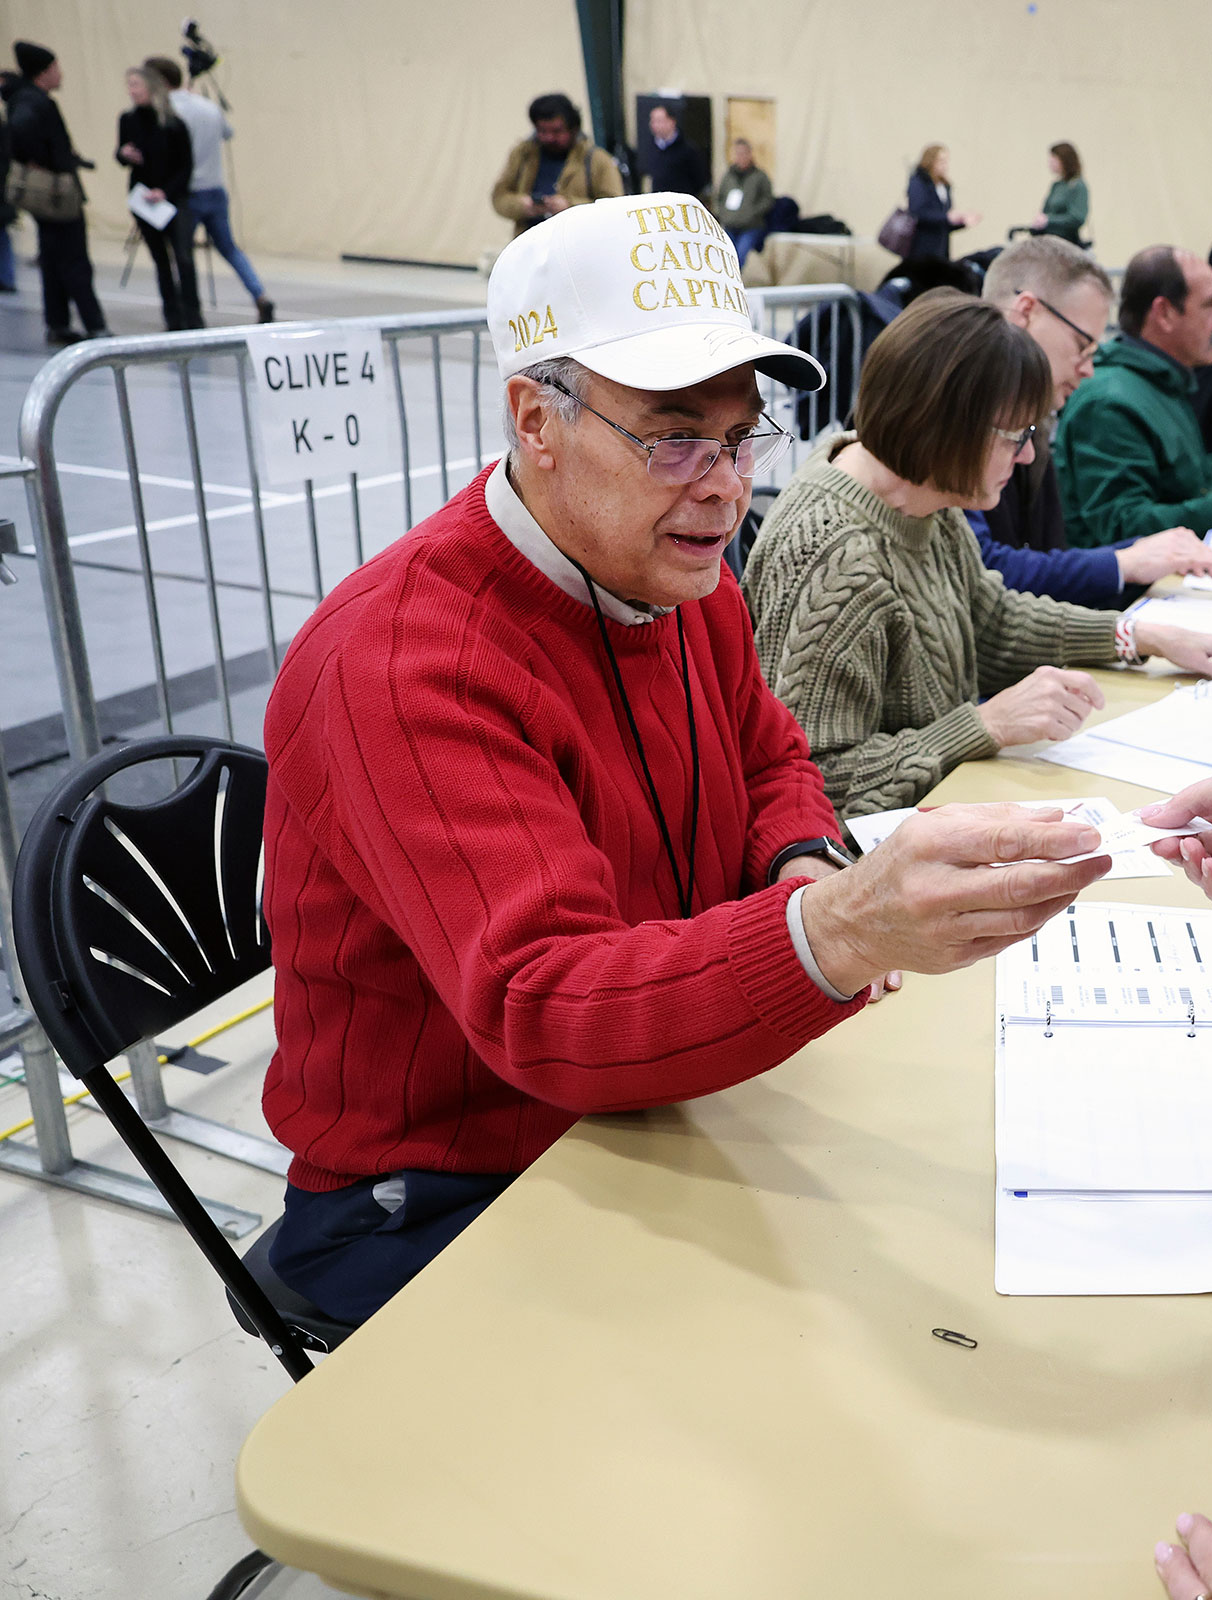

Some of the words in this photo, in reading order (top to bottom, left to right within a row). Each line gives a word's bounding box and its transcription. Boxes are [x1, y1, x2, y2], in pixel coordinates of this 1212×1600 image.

[509, 304, 558, 352] 2024
[265, 353, 349, 390] CLIVE
[361, 352, 374, 382] 4
[293, 419, 313, 453] K
